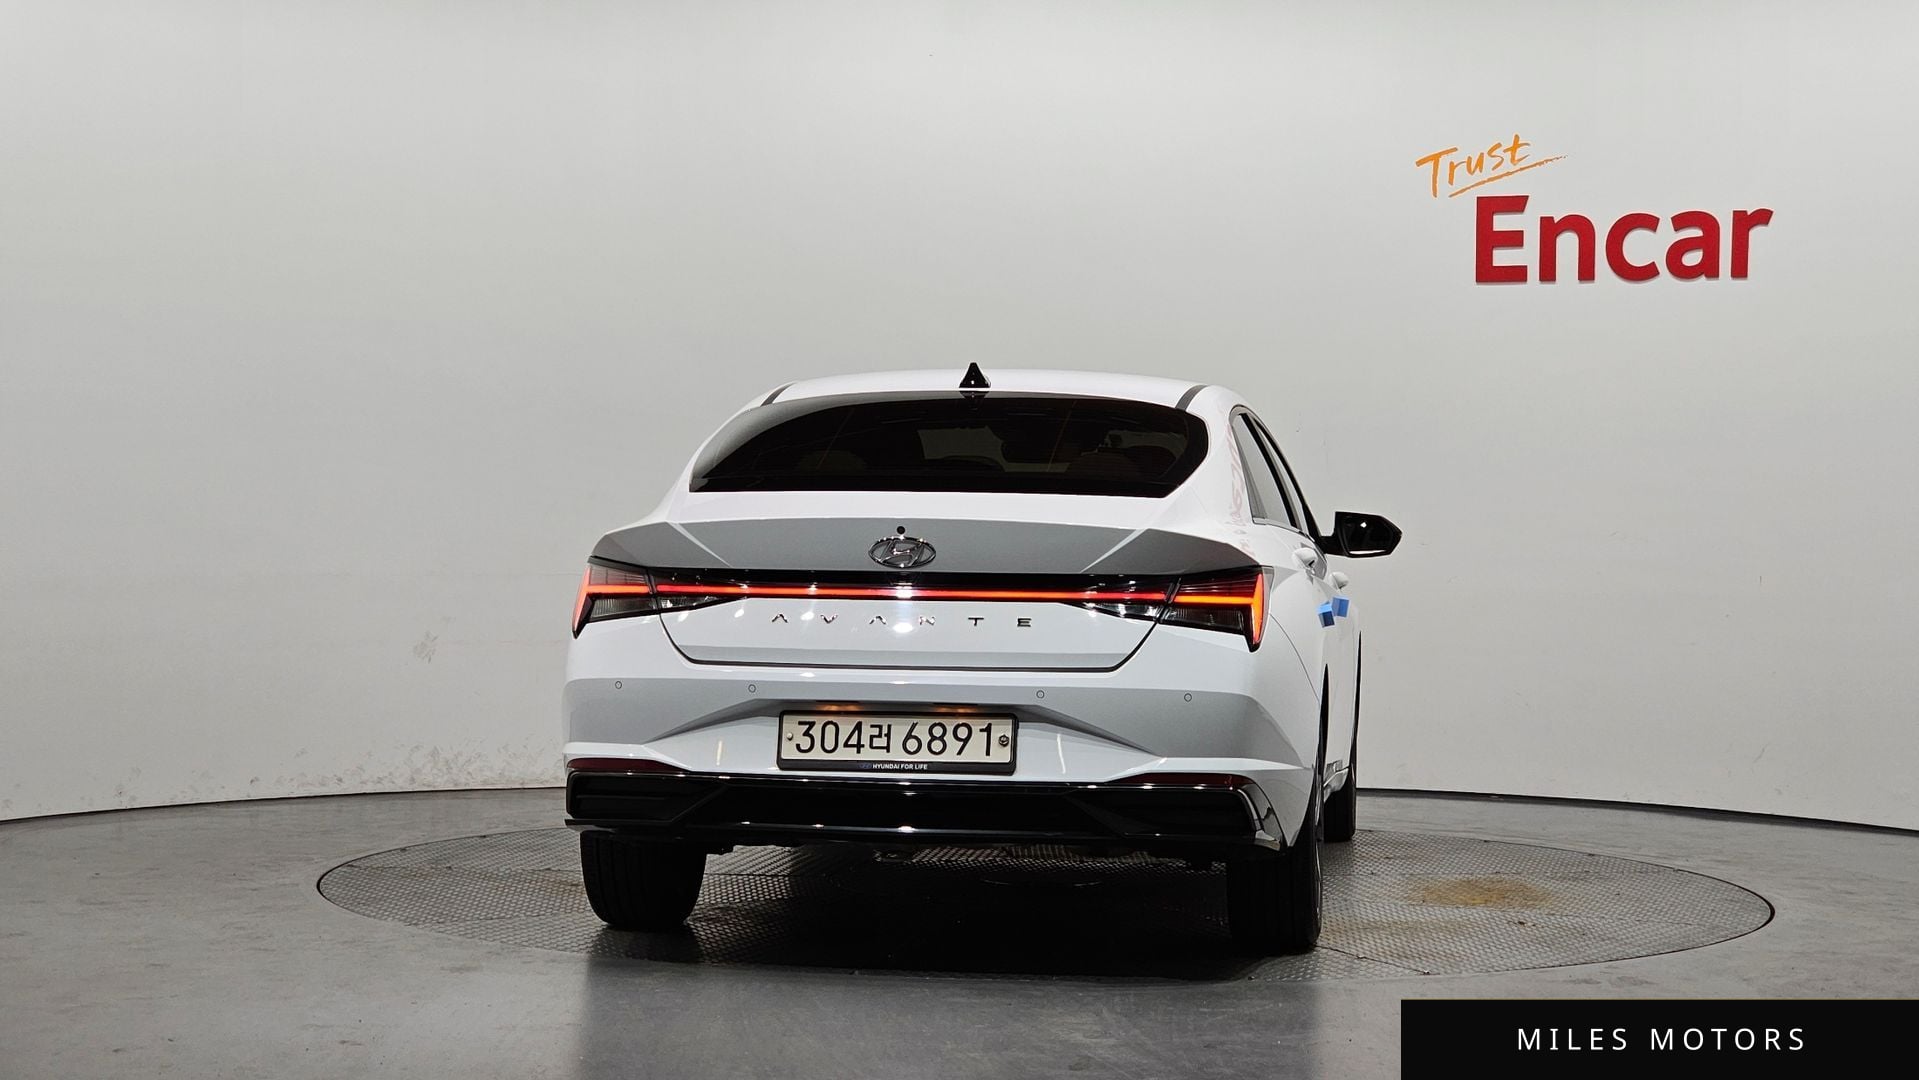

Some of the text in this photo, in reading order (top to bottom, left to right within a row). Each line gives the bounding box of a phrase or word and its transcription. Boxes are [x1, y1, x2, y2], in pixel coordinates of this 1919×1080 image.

[1415, 134, 1531, 198] Trust
[1476, 195, 1774, 283] Encar
[771, 613, 1032, 628] AVANTE
[795, 720, 993, 757] 304러 6891
